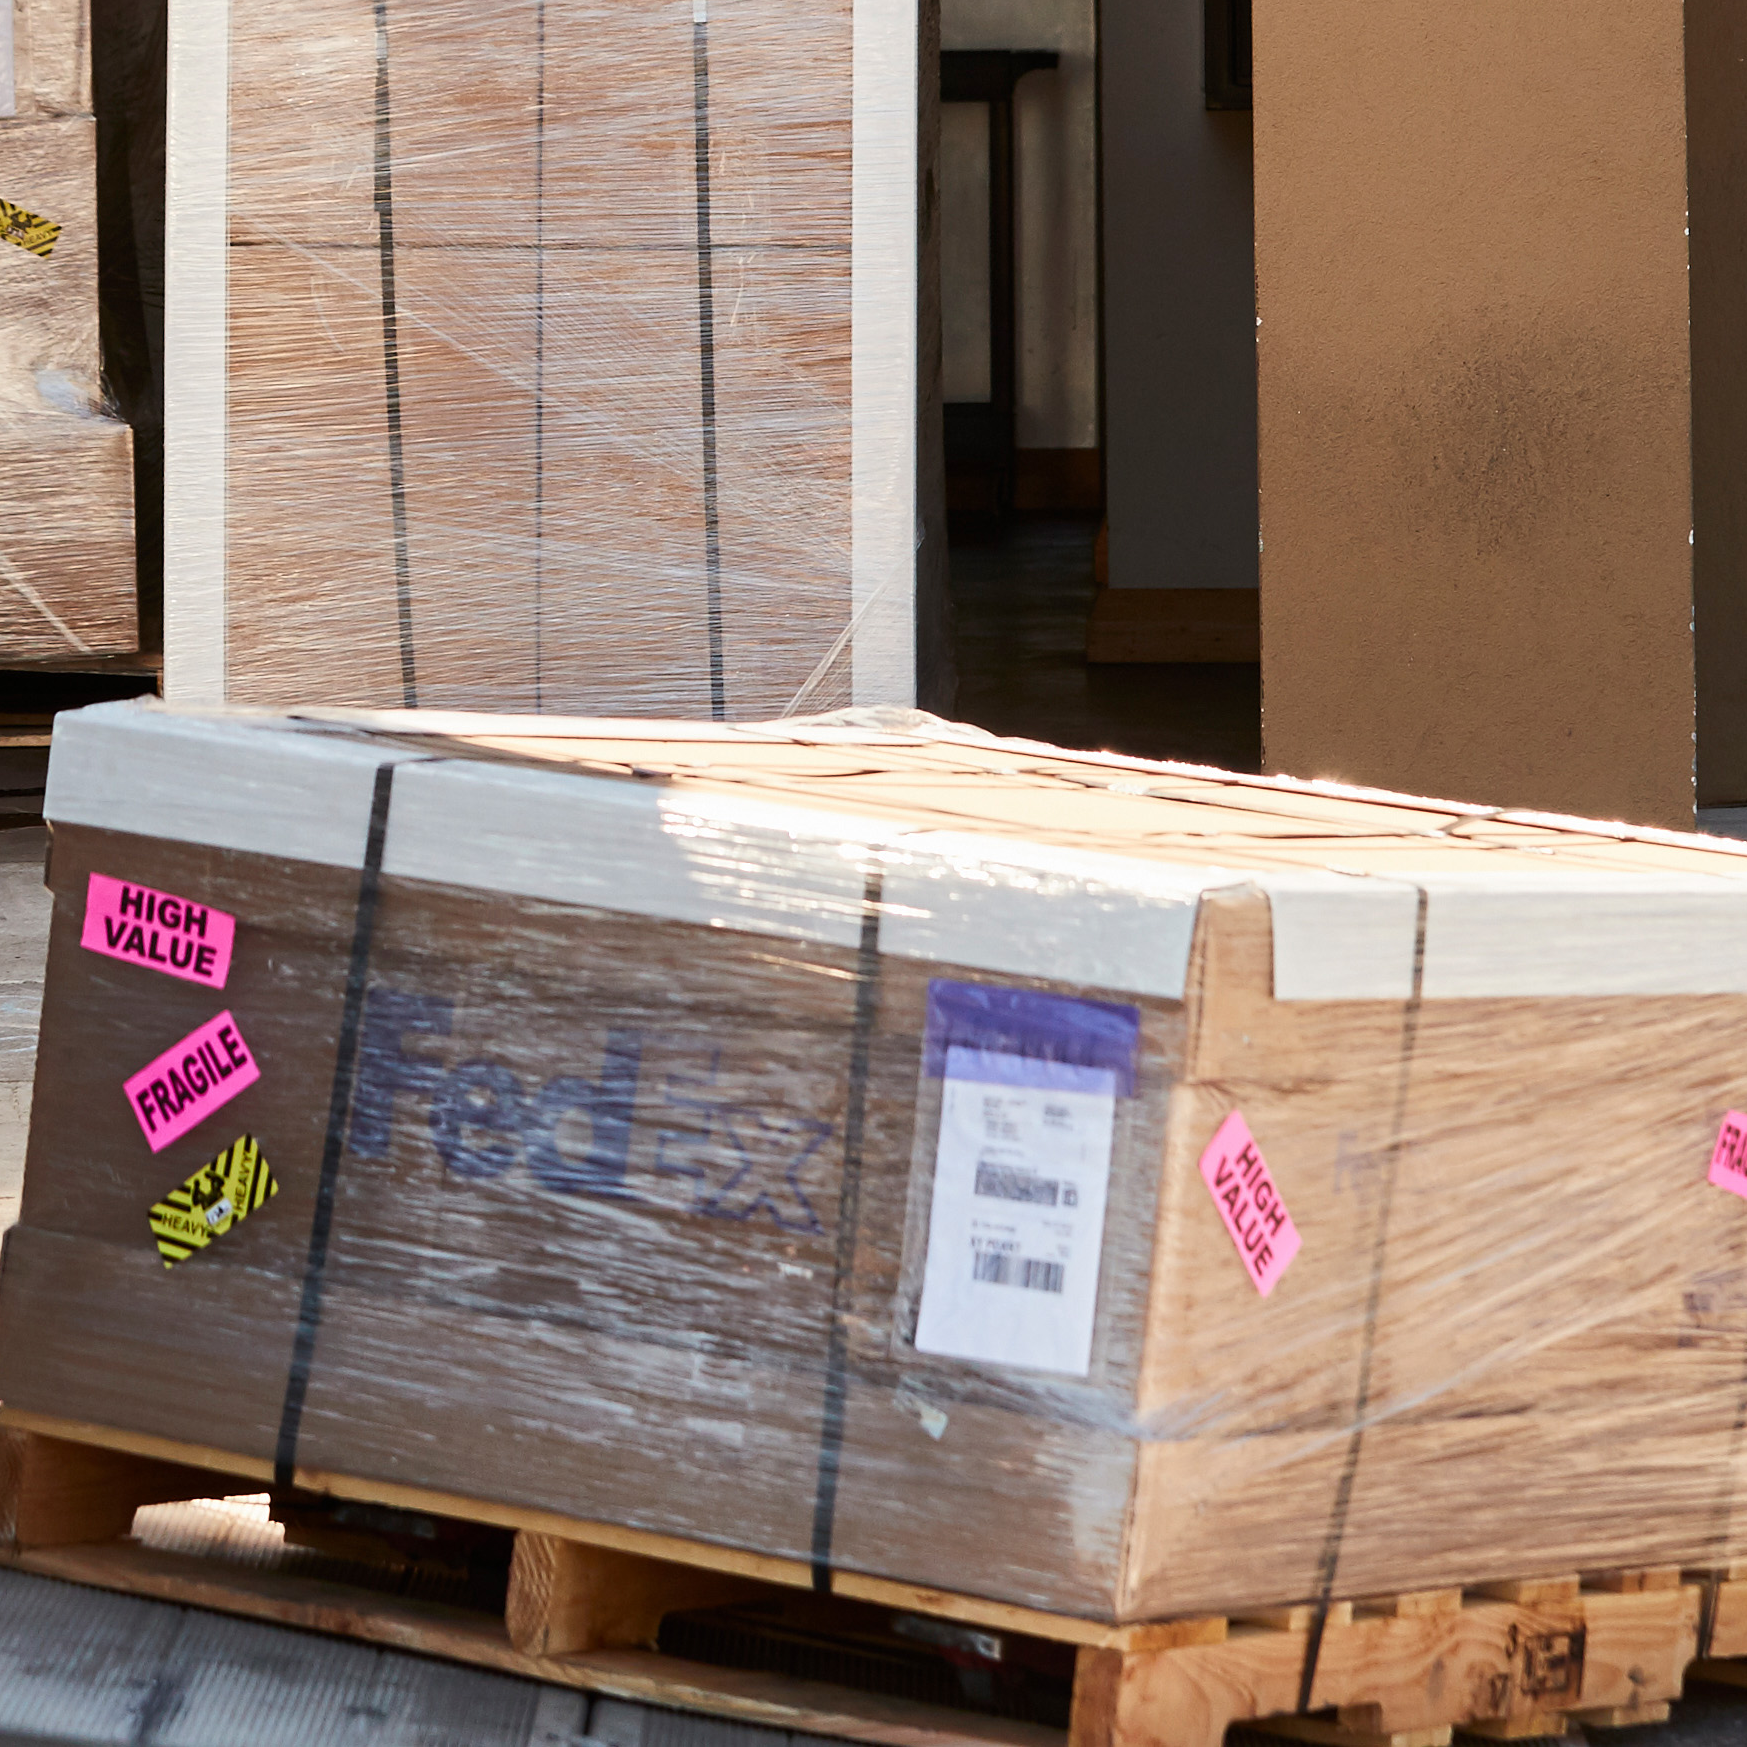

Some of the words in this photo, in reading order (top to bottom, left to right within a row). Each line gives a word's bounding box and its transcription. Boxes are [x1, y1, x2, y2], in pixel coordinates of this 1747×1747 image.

[104, 915, 217, 978] VALUE
[118, 885, 209, 940] HIGH
[135, 1023, 249, 1134] FRAGILE
[348, 984, 837, 1239] FedEx
[232, 1150, 255, 1212] HEAVY
[1214, 1154, 1275, 1277] VALUE
[1235, 1141, 1286, 1238] HIGH
[160, 1211, 208, 1240] HEAVY
